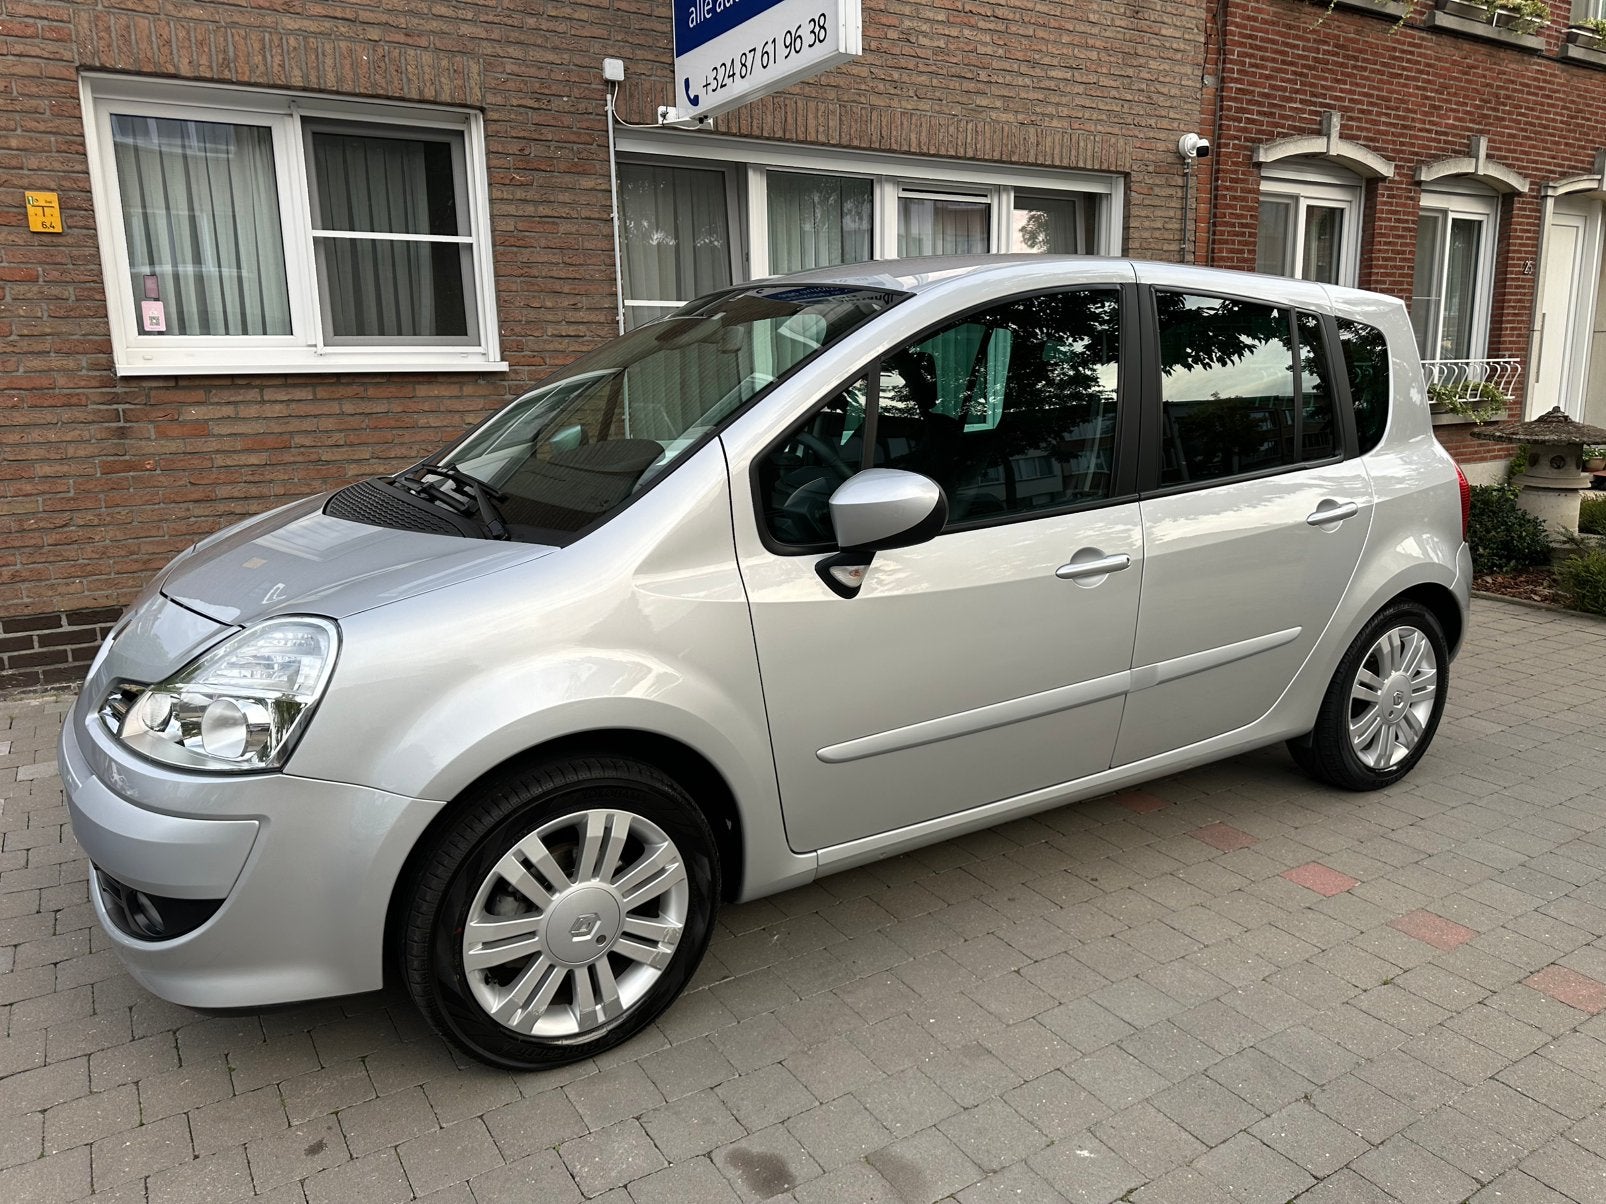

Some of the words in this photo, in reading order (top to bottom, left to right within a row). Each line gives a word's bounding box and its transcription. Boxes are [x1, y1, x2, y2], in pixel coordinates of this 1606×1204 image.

[688, 0, 713, 28] alle
[702, 57, 736, 96] +324
[739, 46, 757, 79] 87
[760, 37, 777, 69] 61
[783, 23, 803, 60] 96
[807, 12, 827, 48] 38
